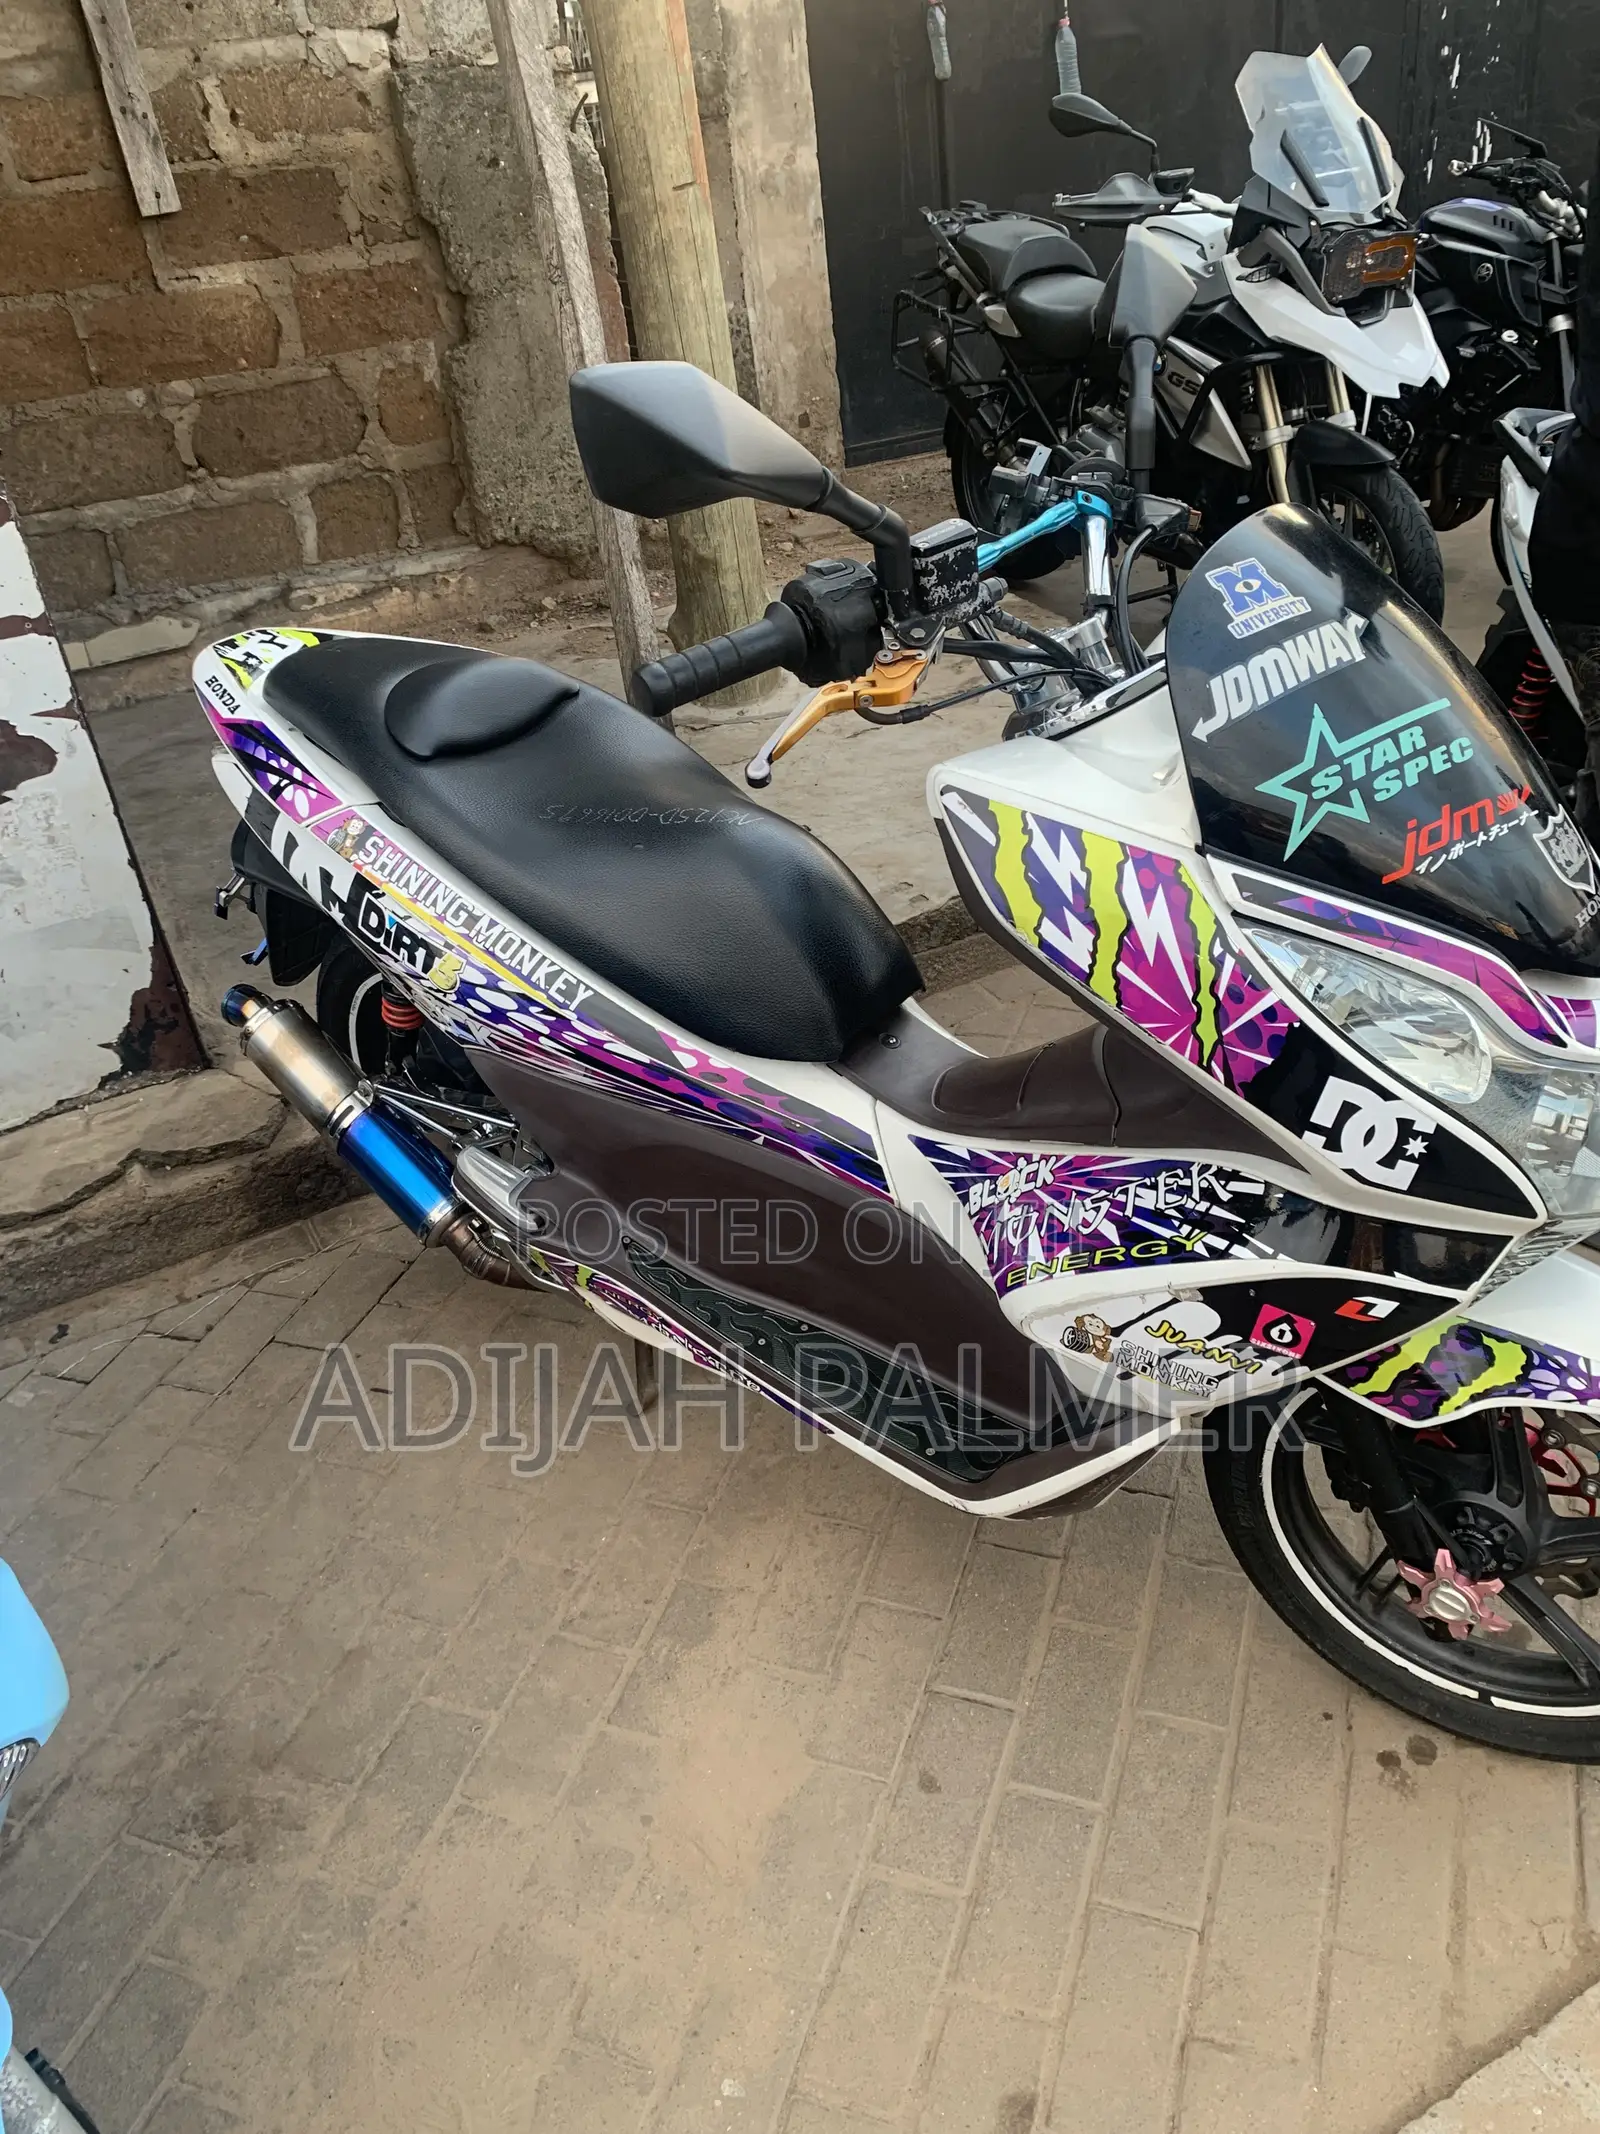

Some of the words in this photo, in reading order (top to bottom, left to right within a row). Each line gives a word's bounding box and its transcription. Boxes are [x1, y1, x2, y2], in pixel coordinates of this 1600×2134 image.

[1230, 599, 1308, 638] UNIVERSITY
[205, 675, 241, 714] HONDA
[1191, 609, 1368, 742] JDMWAY
[1310, 726, 1427, 800] STAR
[1373, 736, 1474, 802] SPEC
[1382, 798, 1496, 885] jdm
[358, 834, 472, 928] SHINING
[469, 914, 595, 1012] MONKEY
[1006, 1231, 1208, 1288] ENERGY
[1116, 1352, 1215, 1398] MONKEY
[1119, 1340, 1220, 1389] SHINING
[1145, 1319, 1263, 1375] JUANVI
